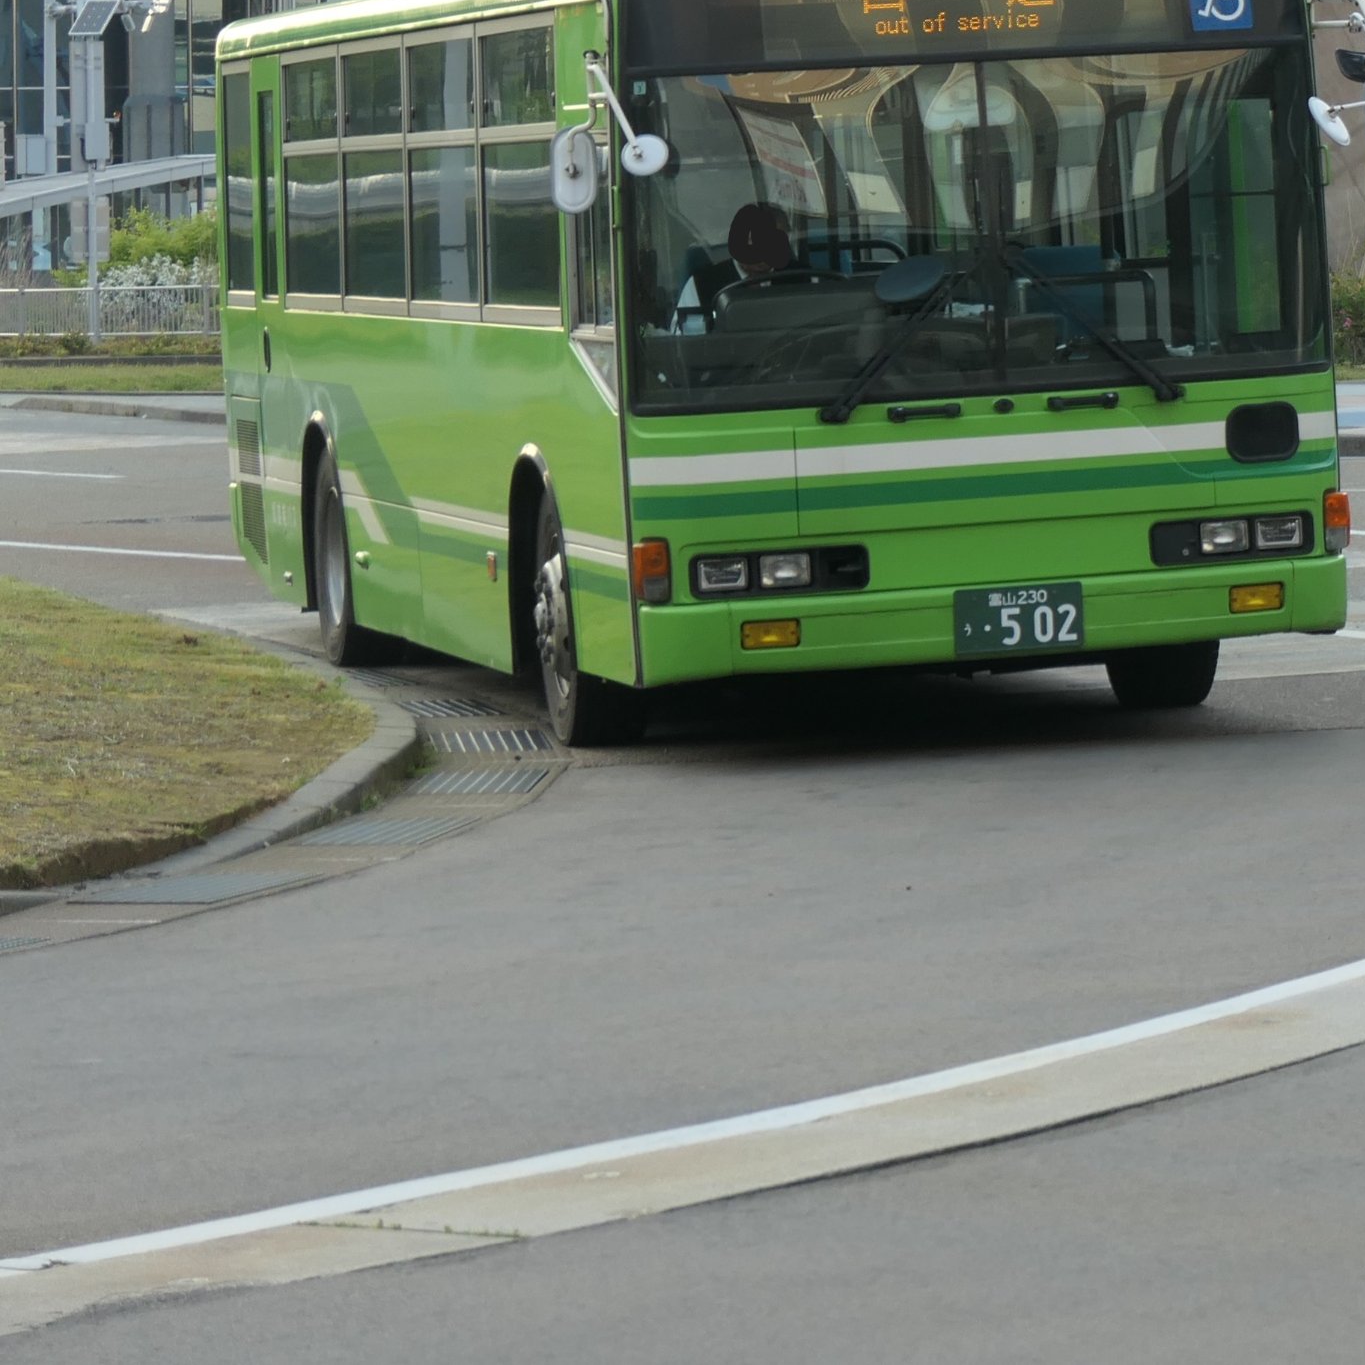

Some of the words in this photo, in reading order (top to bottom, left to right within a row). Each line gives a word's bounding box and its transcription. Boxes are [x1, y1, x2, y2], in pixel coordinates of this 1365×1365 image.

[876, 17, 908, 35] out
[923, 11, 946, 33] of
[957, 9, 1040, 31] service
